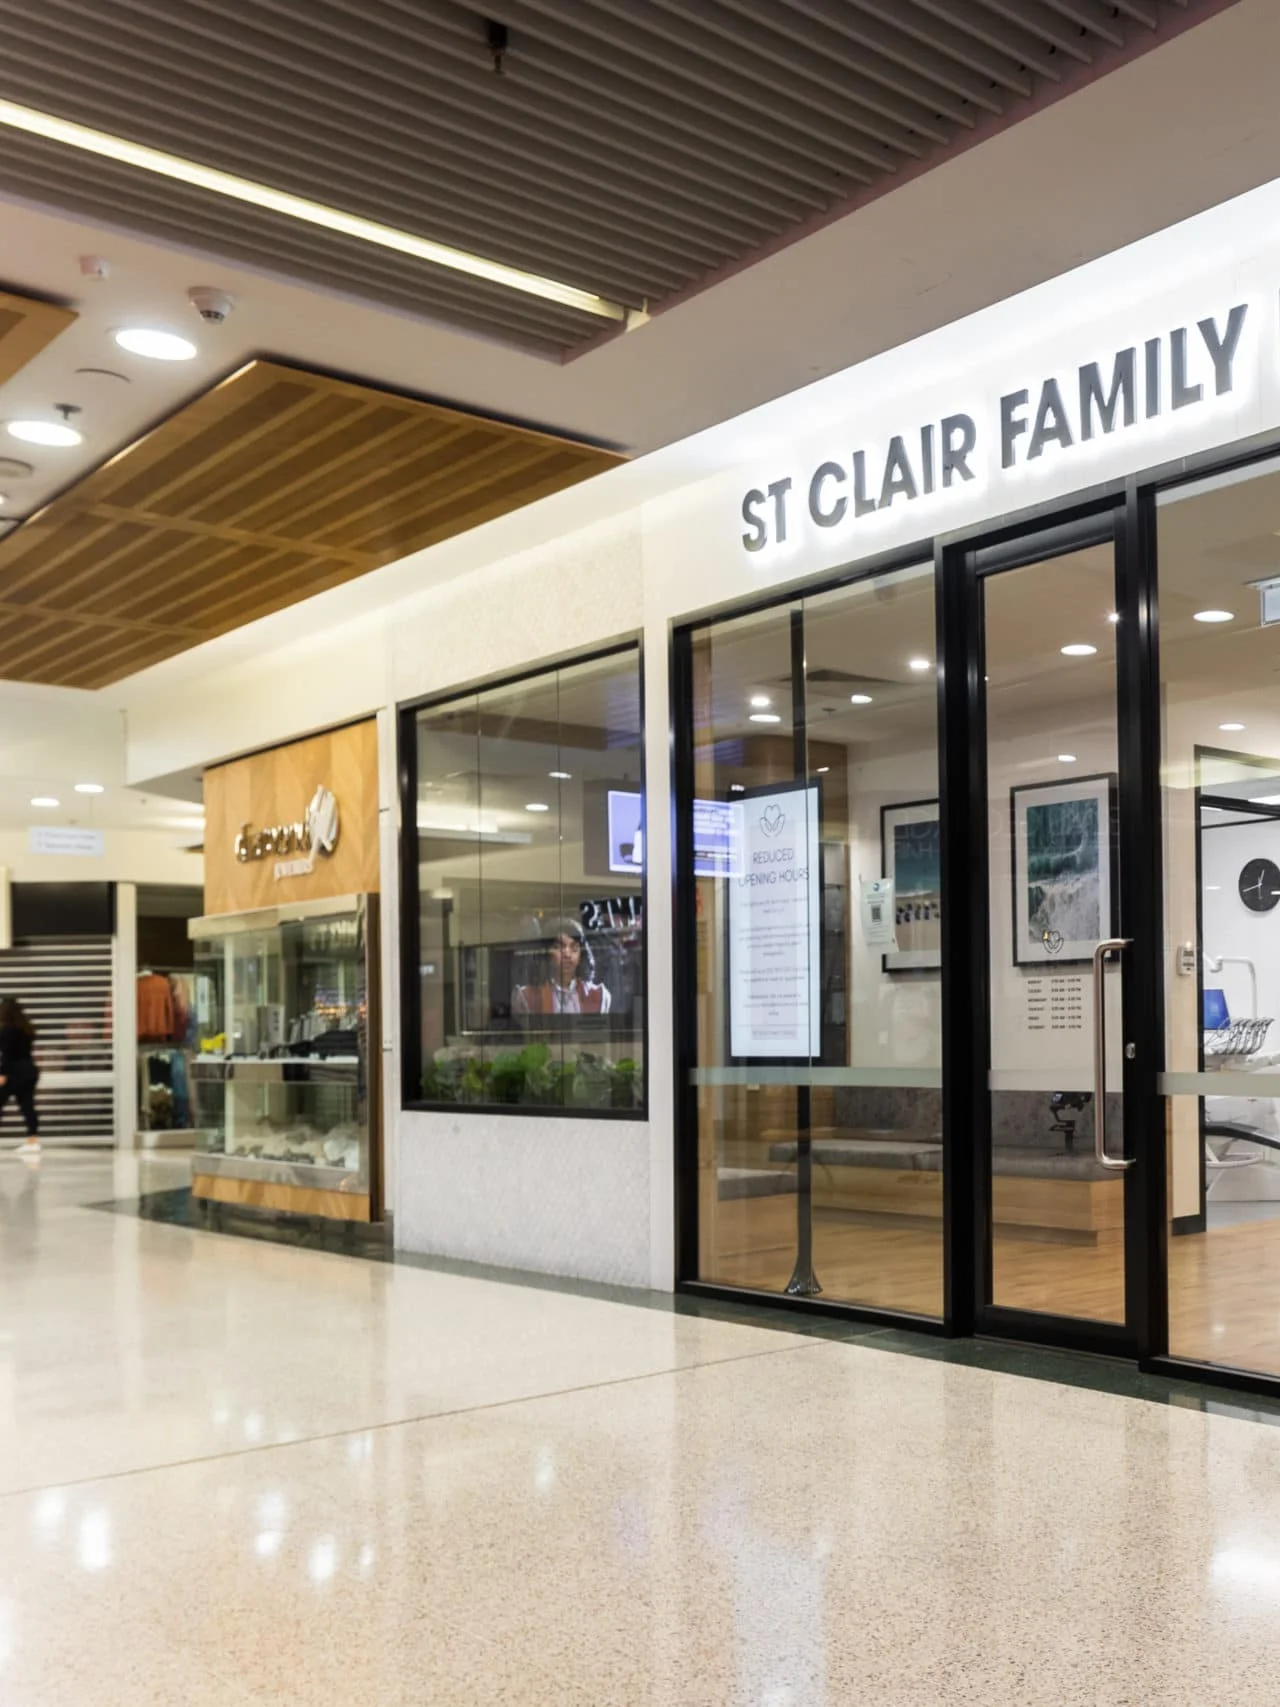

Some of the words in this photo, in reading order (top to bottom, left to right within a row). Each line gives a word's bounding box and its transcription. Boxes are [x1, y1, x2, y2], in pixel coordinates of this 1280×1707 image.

[742, 477, 792, 552] ST
[808, 413, 977, 528] CLAIR
[1000, 303, 1249, 469] FAMILY
[753, 848, 793, 864] REDUCED
[779, 867, 809, 883] HOURS
